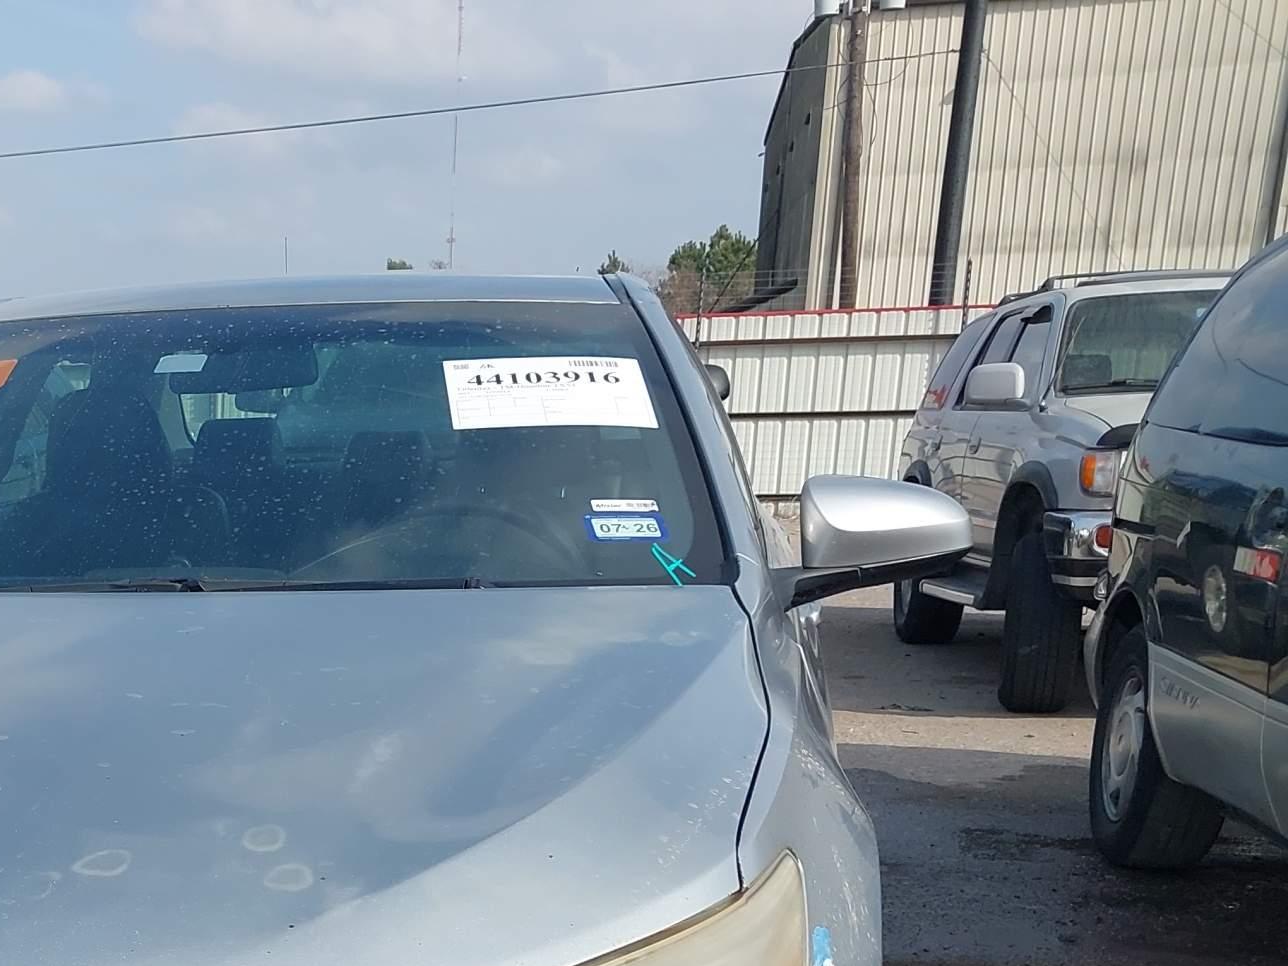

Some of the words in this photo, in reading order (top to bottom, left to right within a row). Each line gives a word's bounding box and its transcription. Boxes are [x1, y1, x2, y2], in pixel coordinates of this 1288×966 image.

[466, 370, 621, 386] 44103916
[599, 523, 622, 533] 07
[633, 523, 658, 533] 26
